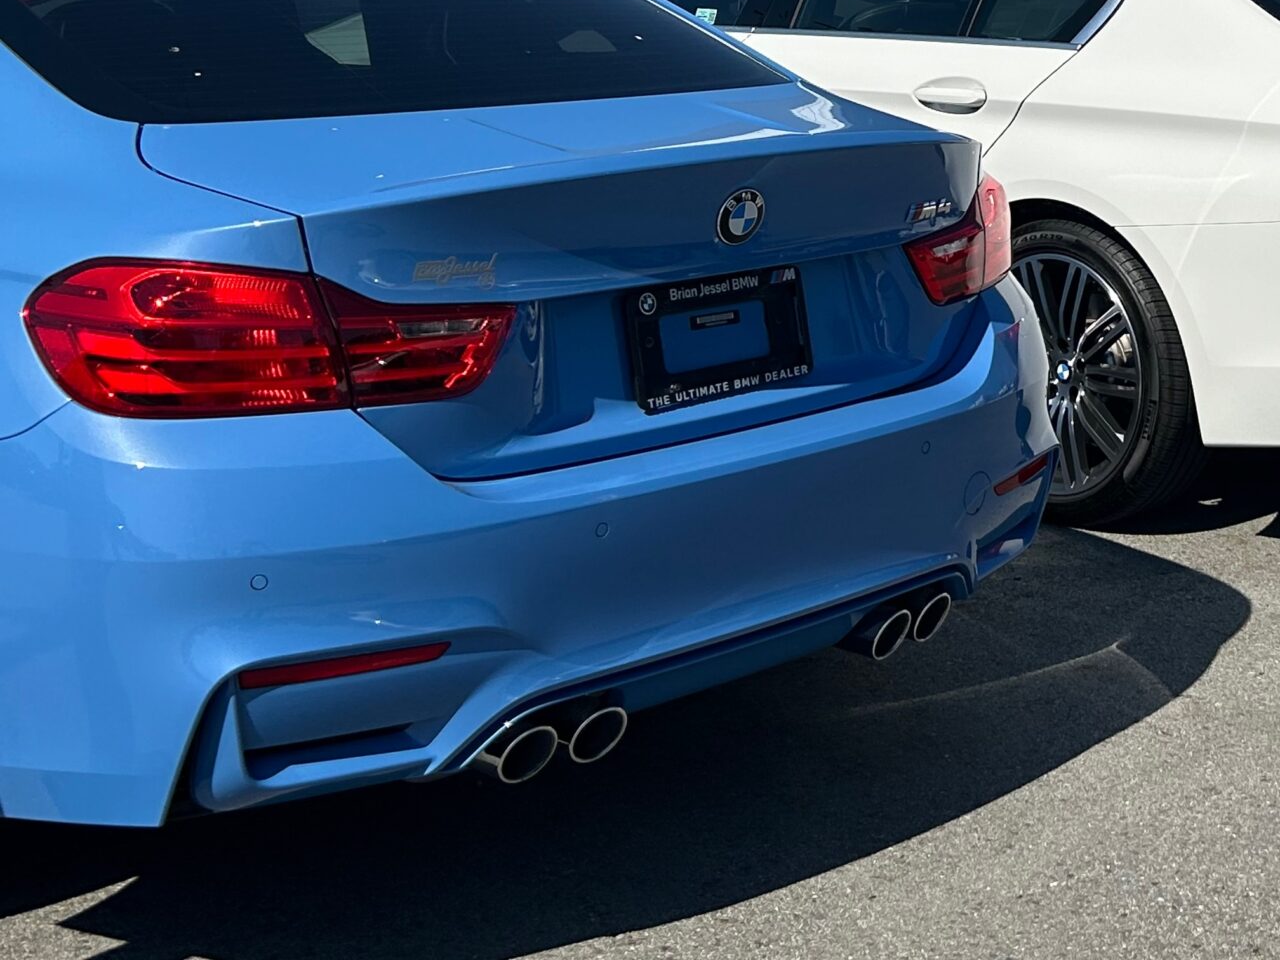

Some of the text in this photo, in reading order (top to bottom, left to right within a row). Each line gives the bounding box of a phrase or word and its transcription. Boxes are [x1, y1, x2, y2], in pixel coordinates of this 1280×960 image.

[726, 191, 765, 211] BMW
[669, 286, 698, 301] Brian
[699, 278, 731, 297] Jessel
[732, 275, 760, 290] BMW
[647, 364, 809, 409] THE ULTIMATE BMW DEALER
